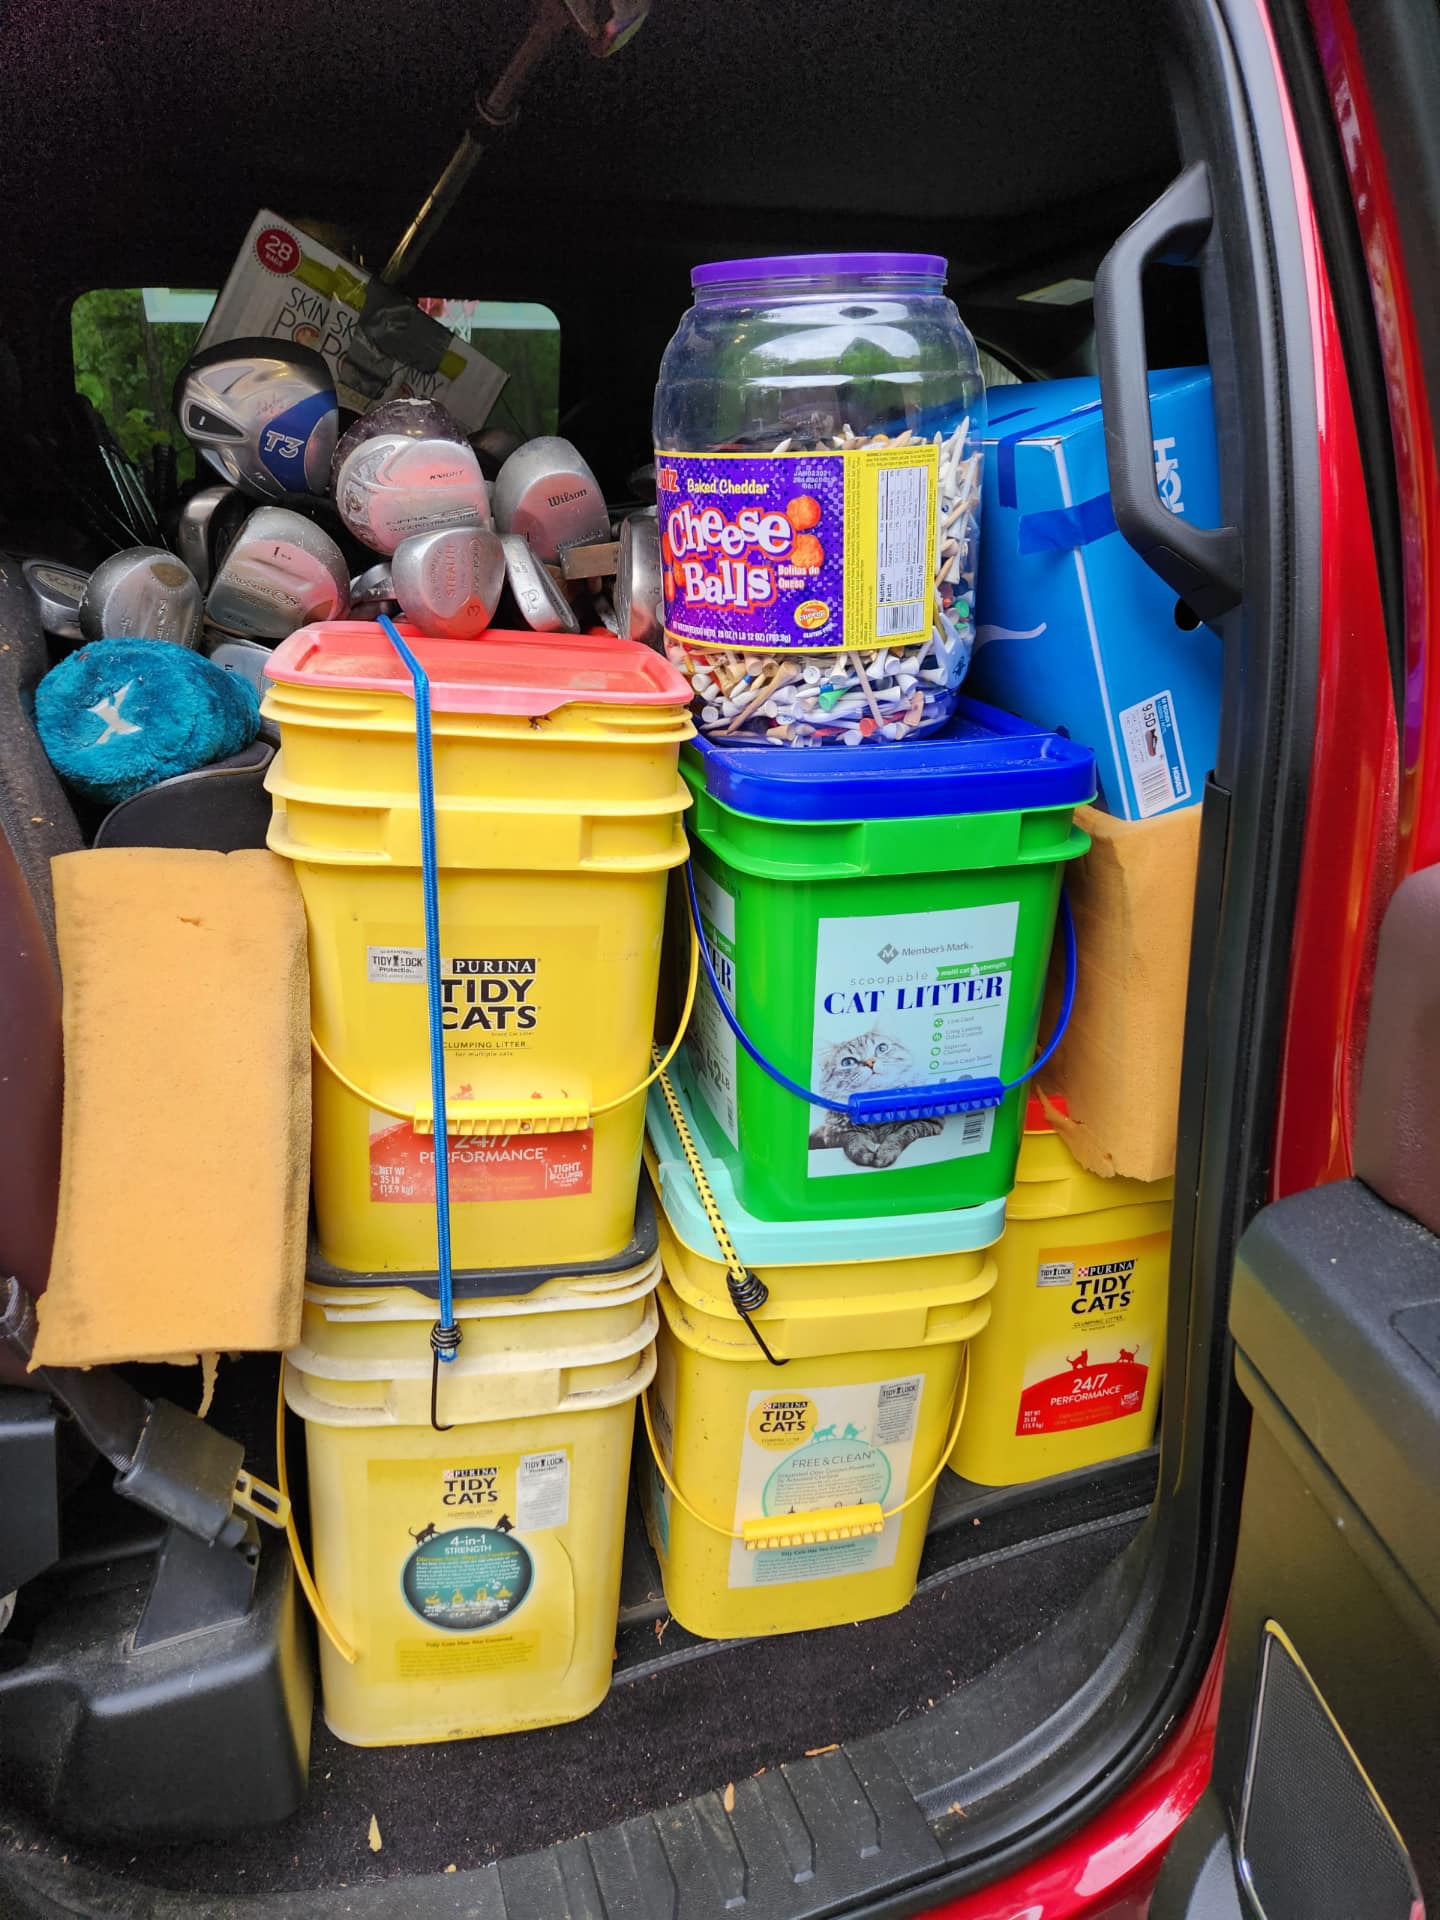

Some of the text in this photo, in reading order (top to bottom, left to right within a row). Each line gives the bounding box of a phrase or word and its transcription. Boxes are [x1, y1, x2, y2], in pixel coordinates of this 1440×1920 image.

[264, 235, 293, 261] 28
[263, 430, 305, 459] T3
[687, 478, 769, 494] Baked Cheddar
[547, 488, 588, 508] Wilson
[667, 505, 791, 557] Cheese
[778, 565, 820, 576] Bolitas de
[682, 560, 771, 607] Balls
[1142, 703, 1156, 728] 9.5D
[901, 944, 945, 957] Member's
[946, 942, 969, 952] Mark
[373, 956, 423, 967] TIDY LOCK
[455, 960, 533, 973] PURINA
[850, 970, 929, 986] scoopable
[440, 979, 535, 1003] TIDY
[823, 976, 1004, 1015] CAT LITTER
[441, 1006, 537, 1030] CATS
[496, 1041, 526, 1049] LITTER
[419, 1147, 544, 1164] PEFORMANCE
[553, 1161, 581, 1173] TIGHT
[1057, 1268, 1071, 1277] LOCK
[1090, 1261, 1133, 1276] PURINA
[1076, 1273, 1132, 1296] TIDY
[1071, 1291, 1131, 1314] CATS
[901, 1386, 916, 1394] LOCK
[1072, 1373, 1109, 1394] 24/7
[1050, 1384, 1121, 1406] PERFORMANCE
[772, 1401, 807, 1409] PURINA
[762, 1410, 806, 1421] TIDY
[759, 1421, 806, 1432] CATS
[525, 1457, 564, 1470] TIDY LOCK
[455, 1468, 497, 1477] PURINA
[444, 1477, 496, 1492] TIDY
[442, 1491, 499, 1505] CATS
[450, 1534, 486, 1546] 4-in-1
[445, 1545, 492, 1555] STRENGTH
